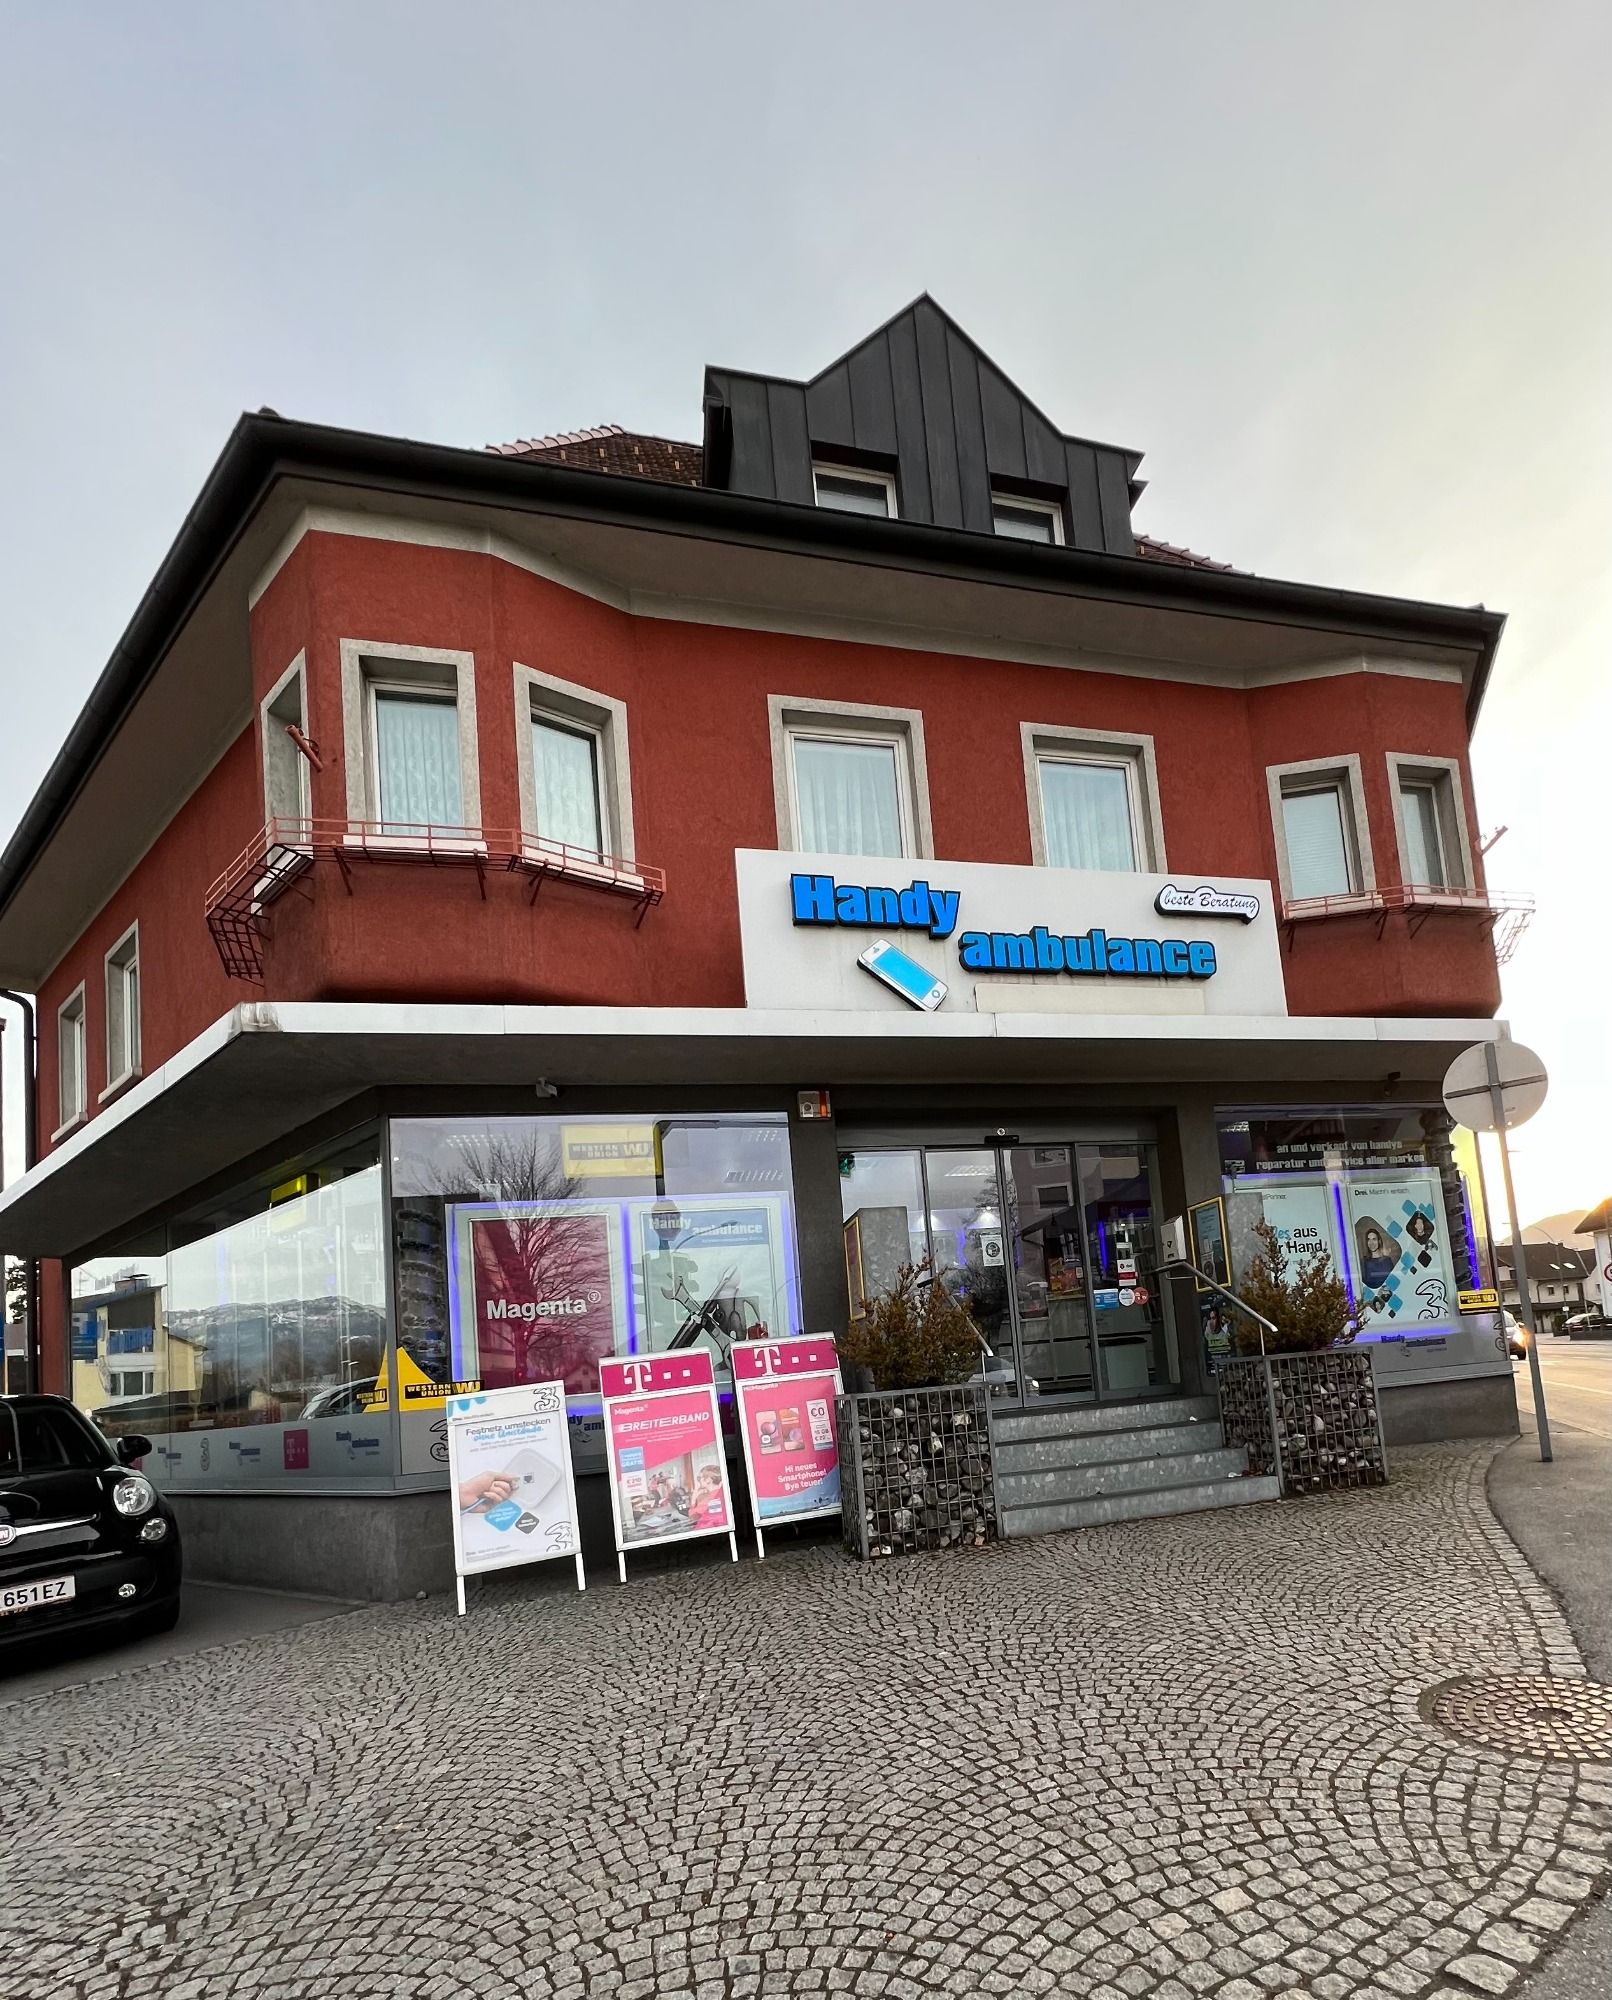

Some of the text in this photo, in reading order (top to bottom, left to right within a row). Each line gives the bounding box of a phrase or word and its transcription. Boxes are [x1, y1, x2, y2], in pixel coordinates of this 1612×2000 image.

[791, 873, 961, 940] Handy
[1164, 891, 1257, 914] beste Beratung
[958, 926, 1217, 978] ambulance
[572, 1143, 649, 1156] WESTERN WU
[1276, 1140, 1402, 1153] an und verkauf von handys
[1256, 1159, 1306, 1170] reparatur
[1366, 1155, 1387, 1165] aller
[1389, 1154, 1425, 1164] marken
[649, 1216, 691, 1230] Handy
[692, 1223, 763, 1236] ambulance
[1293, 1227, 1318, 1238] aus
[487, 1296, 588, 1322] Magenta
[407, 1381, 481, 1394] WESTERN WU
[614, 1406, 645, 1416] Magenta
[466, 1418, 551, 1436] Festnetz umstecken
[618, 1412, 710, 1433] BREITERBAND
[778, 1468, 827, 1483] Smartphone!
[785, 1465, 794, 1473] Hi
[785, 1478, 824, 1491] Bye teuer!
